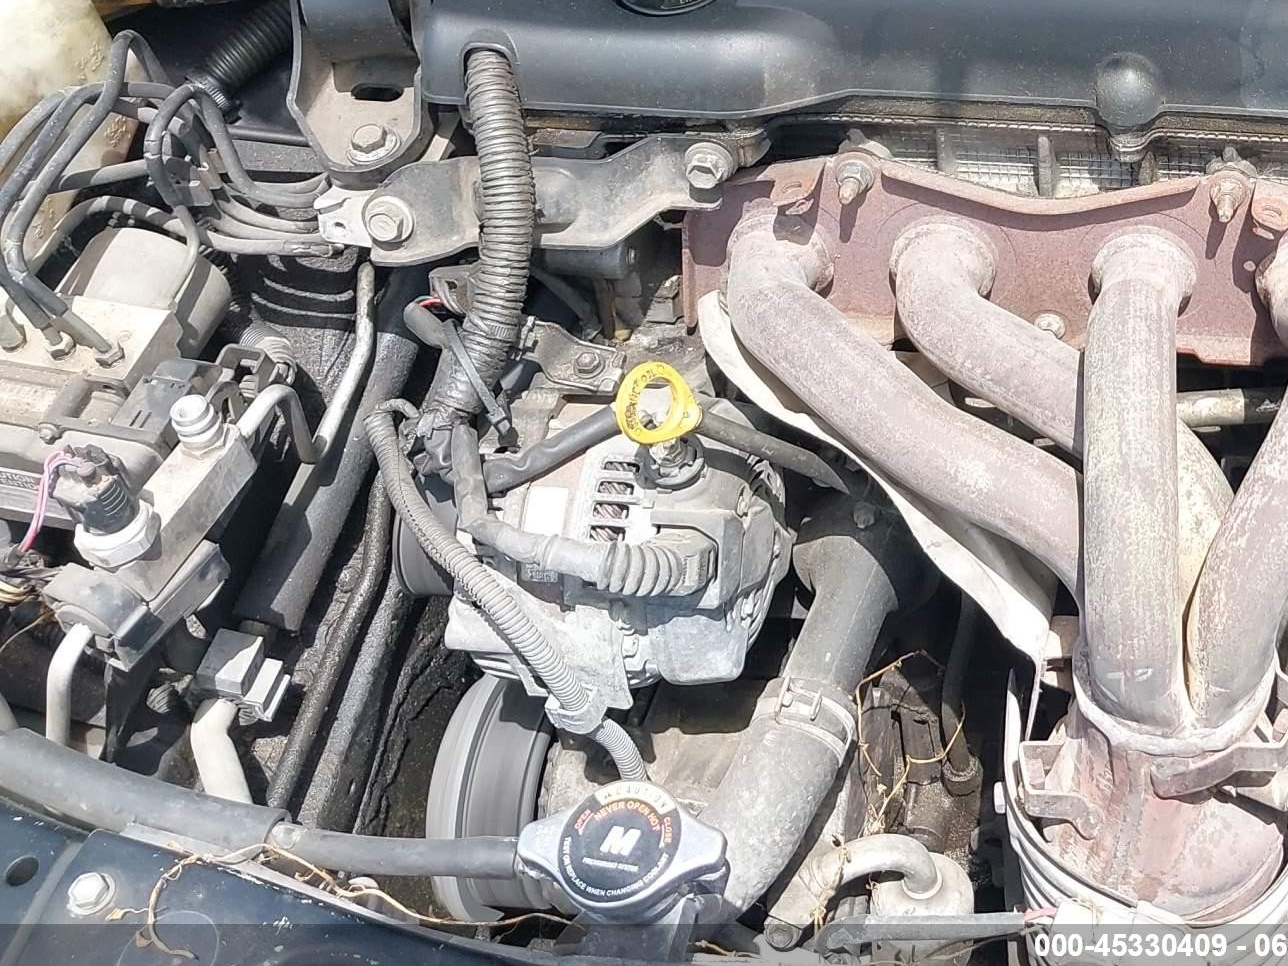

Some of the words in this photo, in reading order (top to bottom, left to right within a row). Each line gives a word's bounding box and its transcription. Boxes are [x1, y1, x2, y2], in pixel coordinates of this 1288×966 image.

[574, 809, 592, 830] OPEN
[593, 801, 626, 821] NEVER
[626, 800, 648, 816] OPEN
[647, 812, 661, 832] HOT
[663, 816, 673, 843] CLOSE
[565, 865, 586, 890] REPLACE
[586, 886, 606, 896] WHEN
[606, 880, 643, 896] CHANGING
[642, 852, 669, 883] COOLANT
